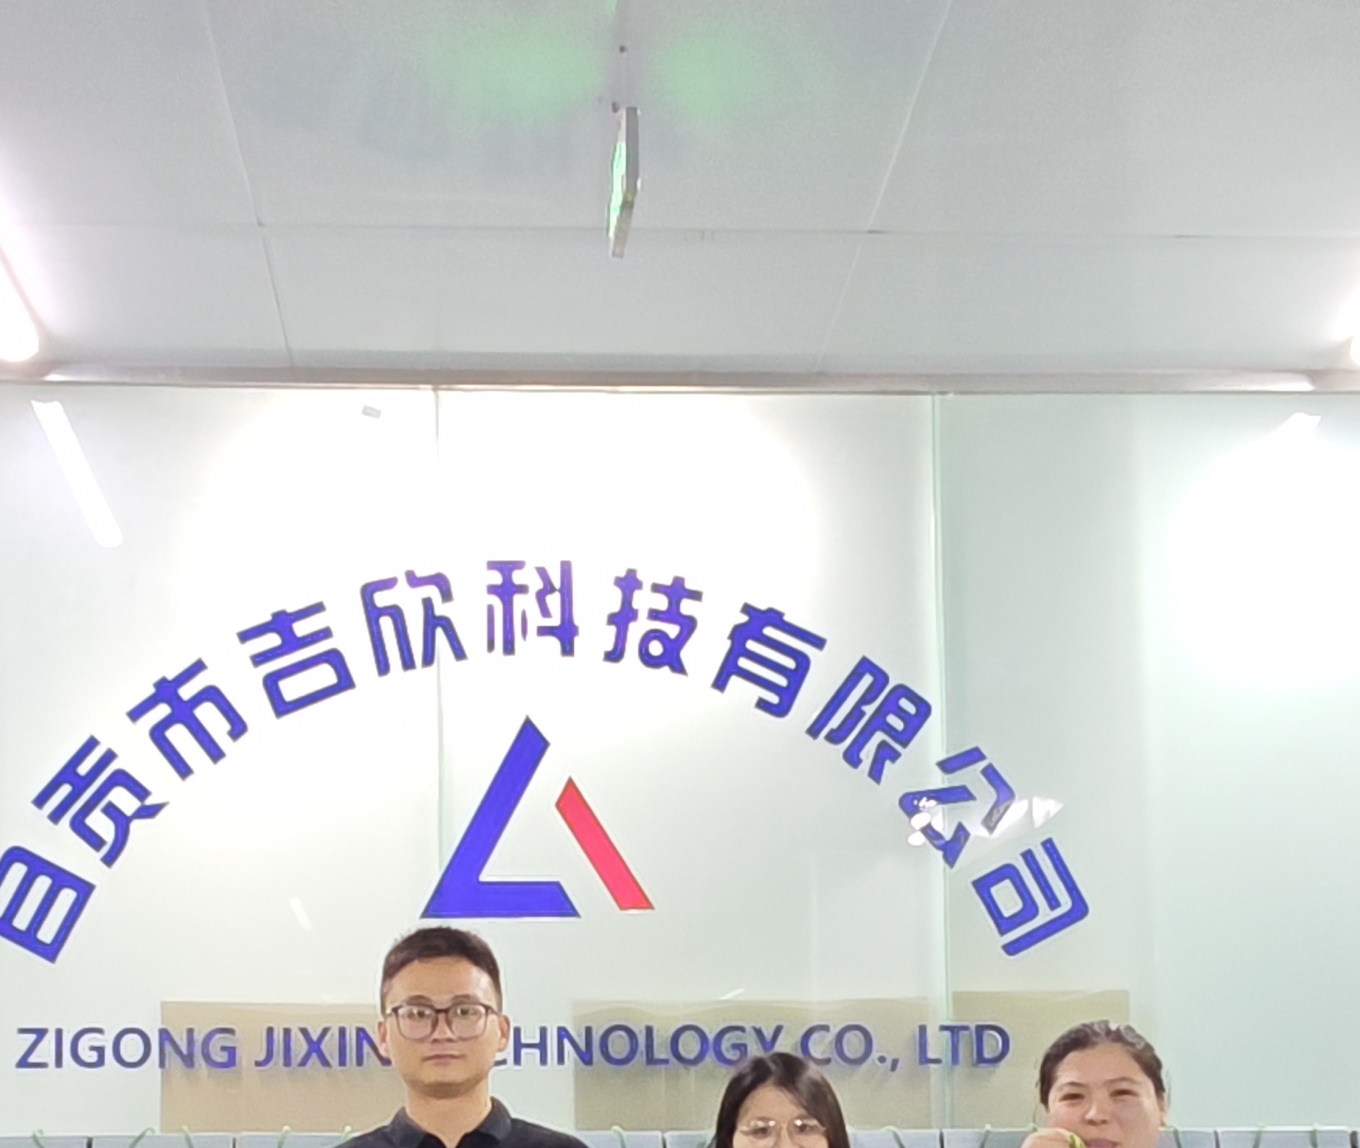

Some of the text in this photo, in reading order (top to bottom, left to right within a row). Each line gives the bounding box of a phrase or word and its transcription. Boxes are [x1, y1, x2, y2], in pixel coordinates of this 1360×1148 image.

[15, 1024, 1011, 1072] ZIGONG JIXIN HNOLOGY CO., LTD
